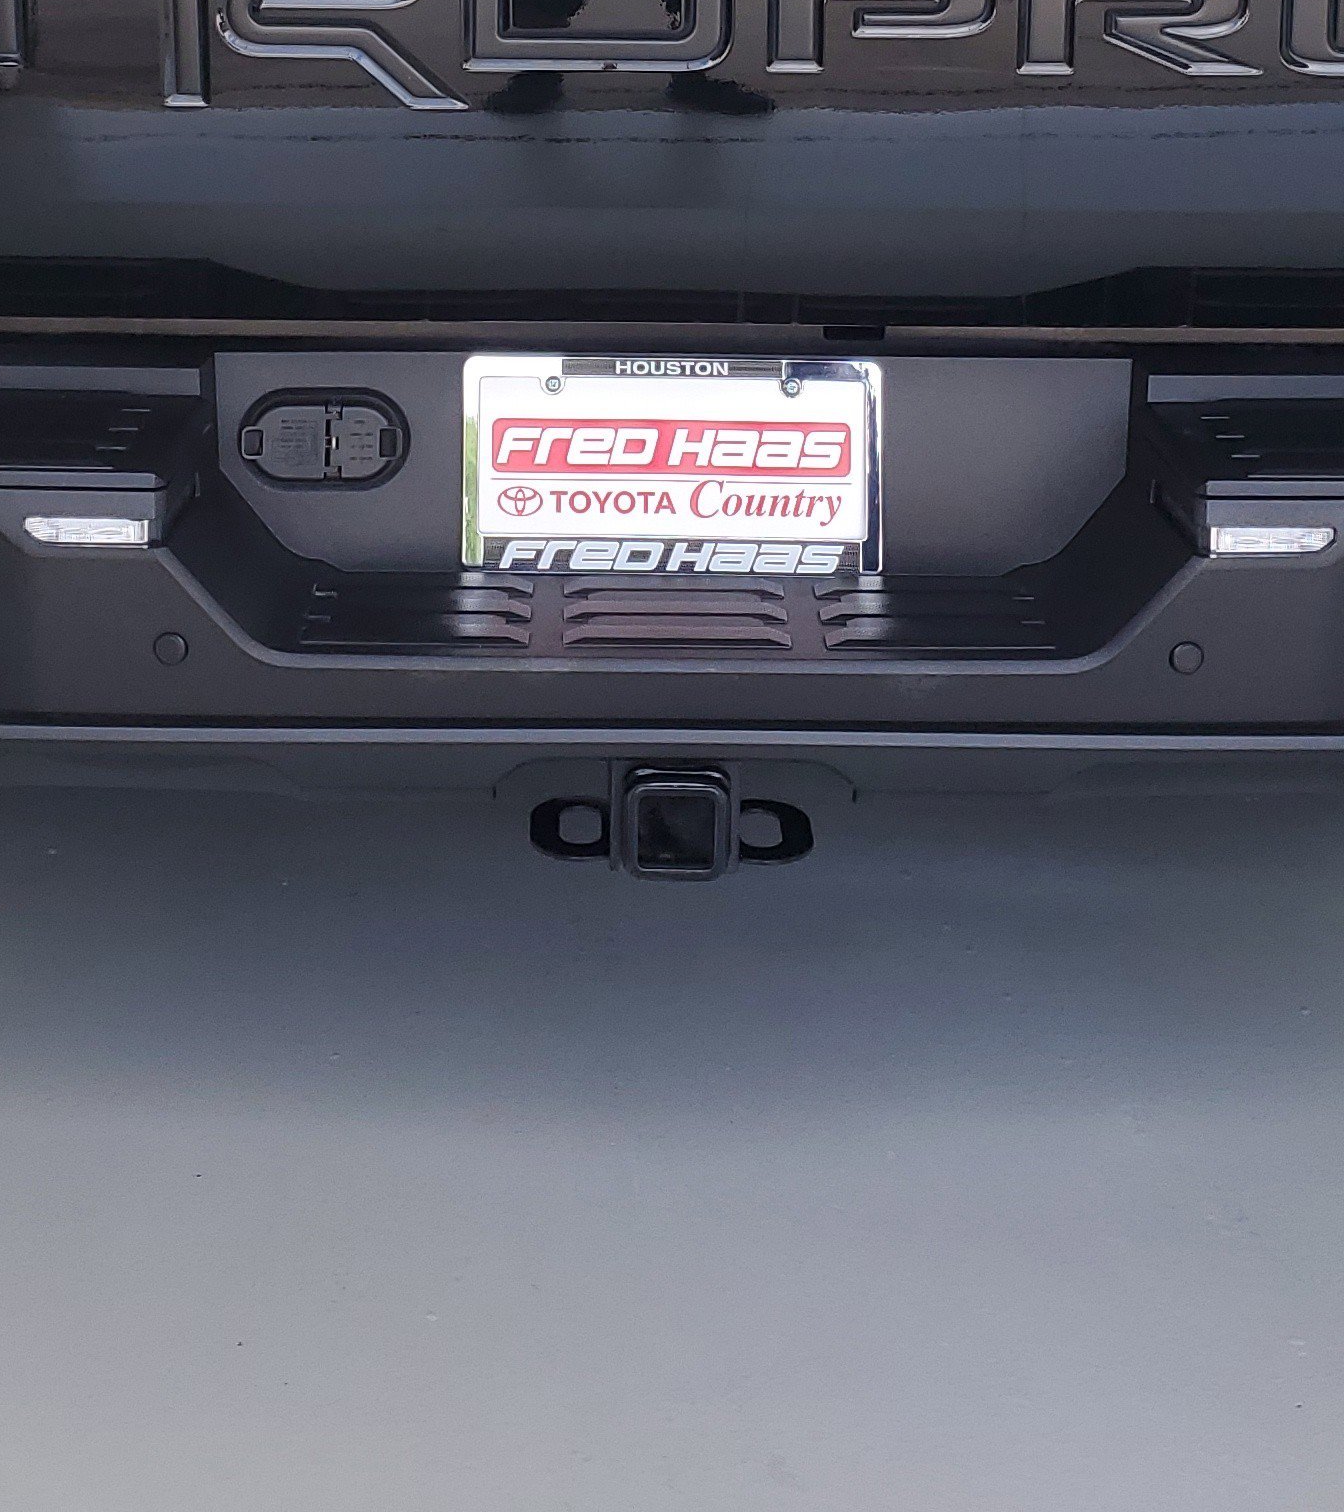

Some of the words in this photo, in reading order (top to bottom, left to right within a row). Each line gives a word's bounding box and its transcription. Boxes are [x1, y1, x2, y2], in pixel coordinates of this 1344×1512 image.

[615, 361, 729, 376] HOUSTON
[549, 489, 677, 515] TOYOTA
[689, 480, 842, 527] Country
